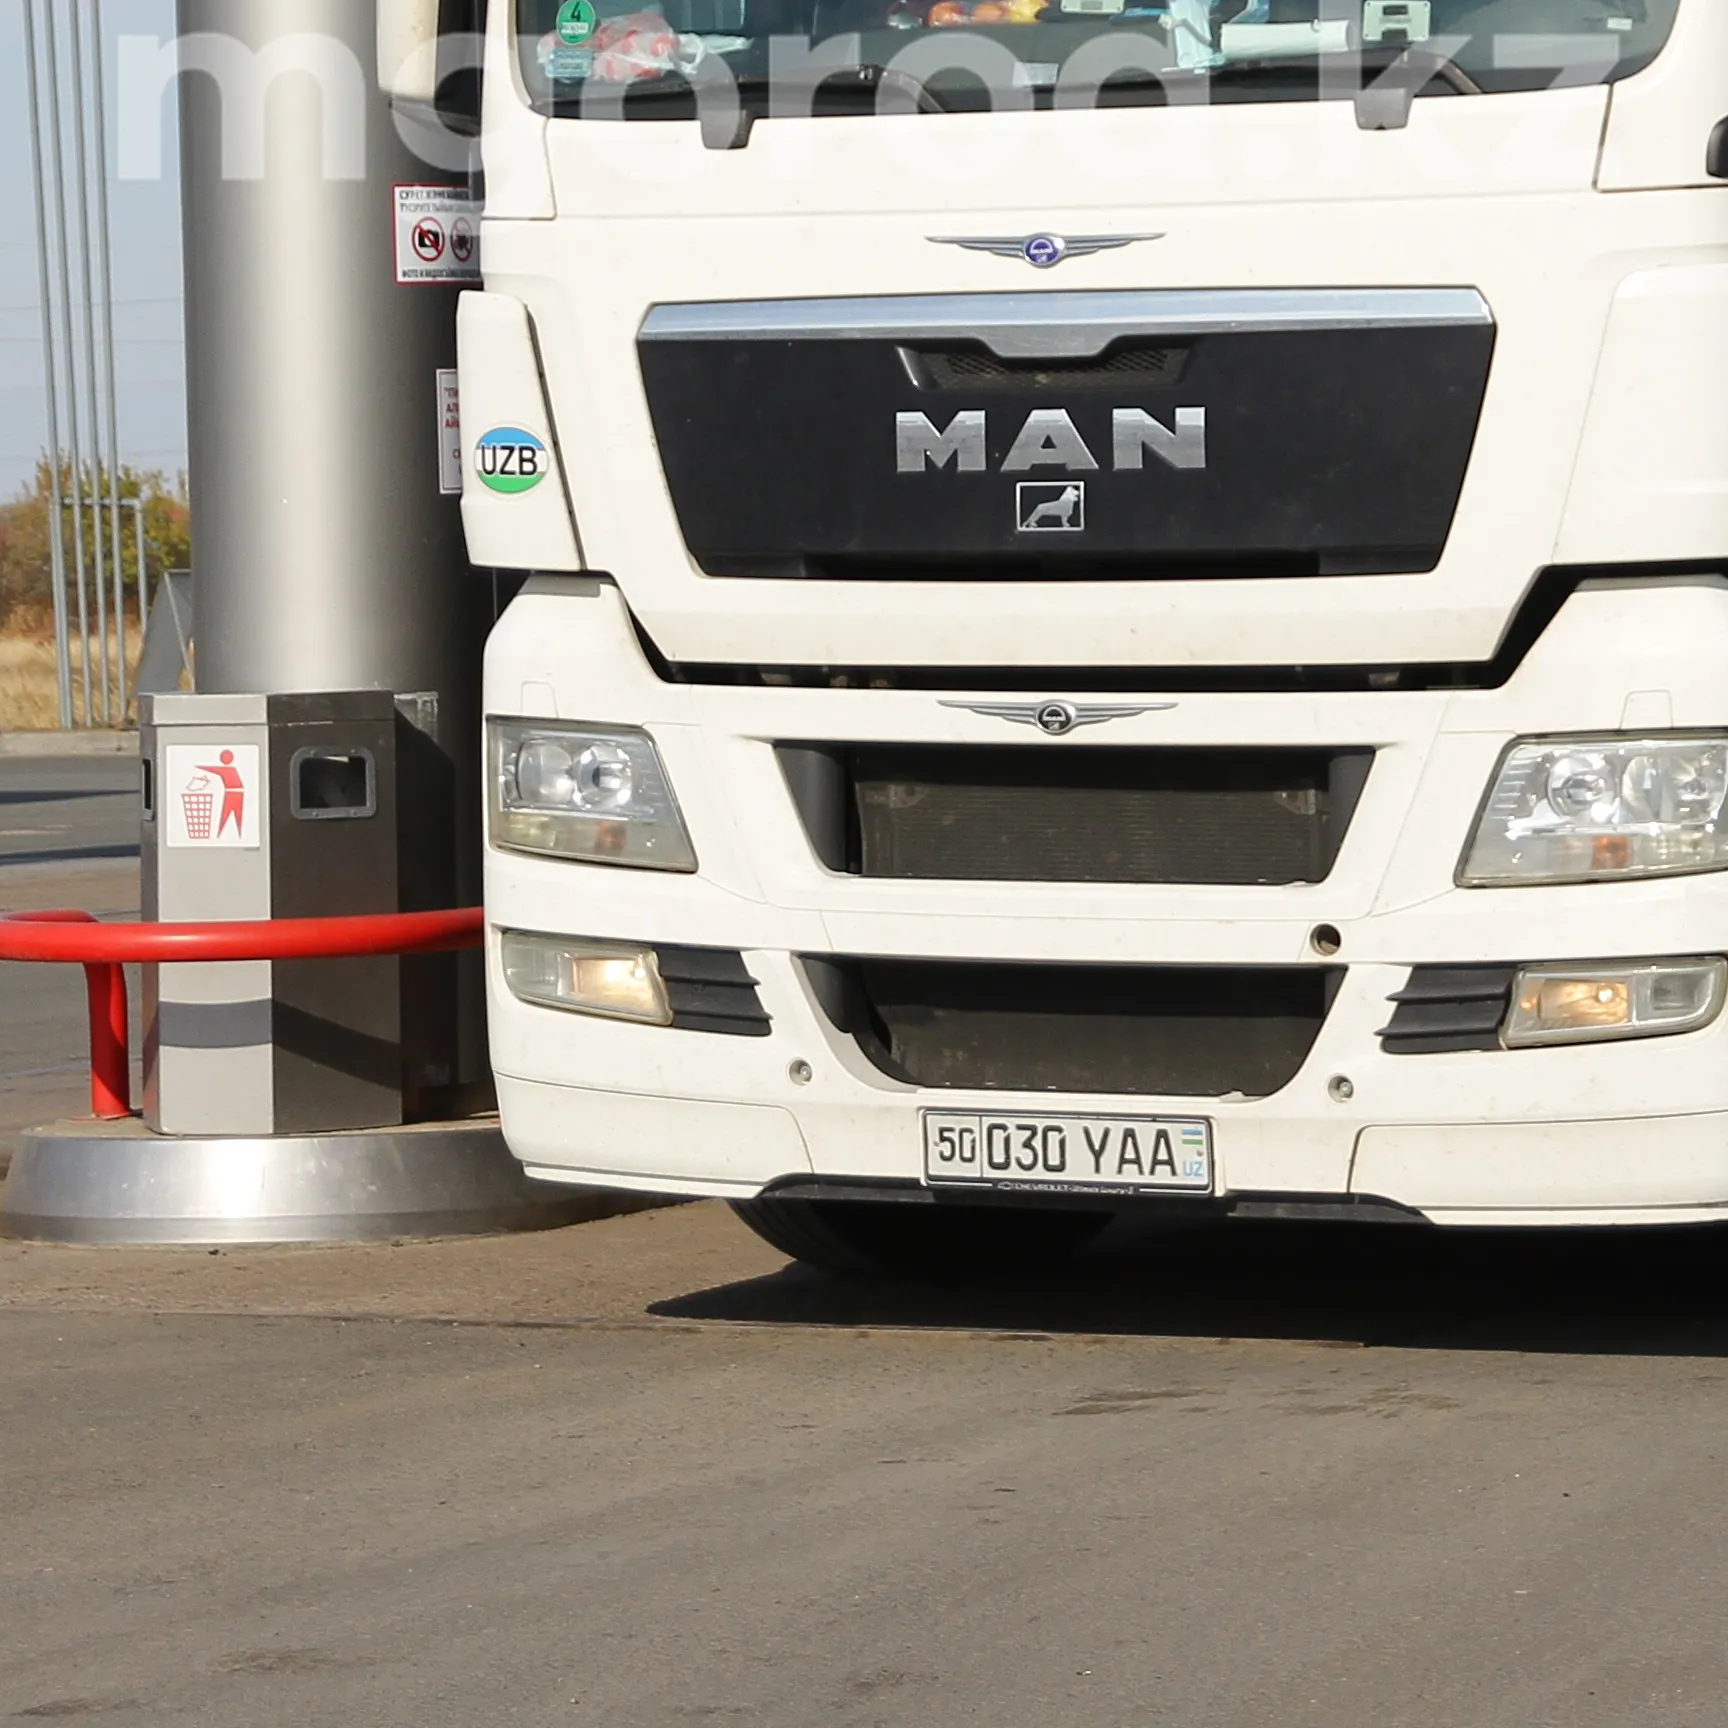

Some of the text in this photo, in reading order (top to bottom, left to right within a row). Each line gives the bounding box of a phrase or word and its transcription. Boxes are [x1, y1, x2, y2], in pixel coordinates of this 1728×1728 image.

[569, 0, 583, 23] 4
[896, 406, 1207, 472] MAN
[480, 444, 539, 476] UZB
[937, 1122, 1178, 1177] 50 030 YAA
[1182, 1160, 1205, 1178] UZ
